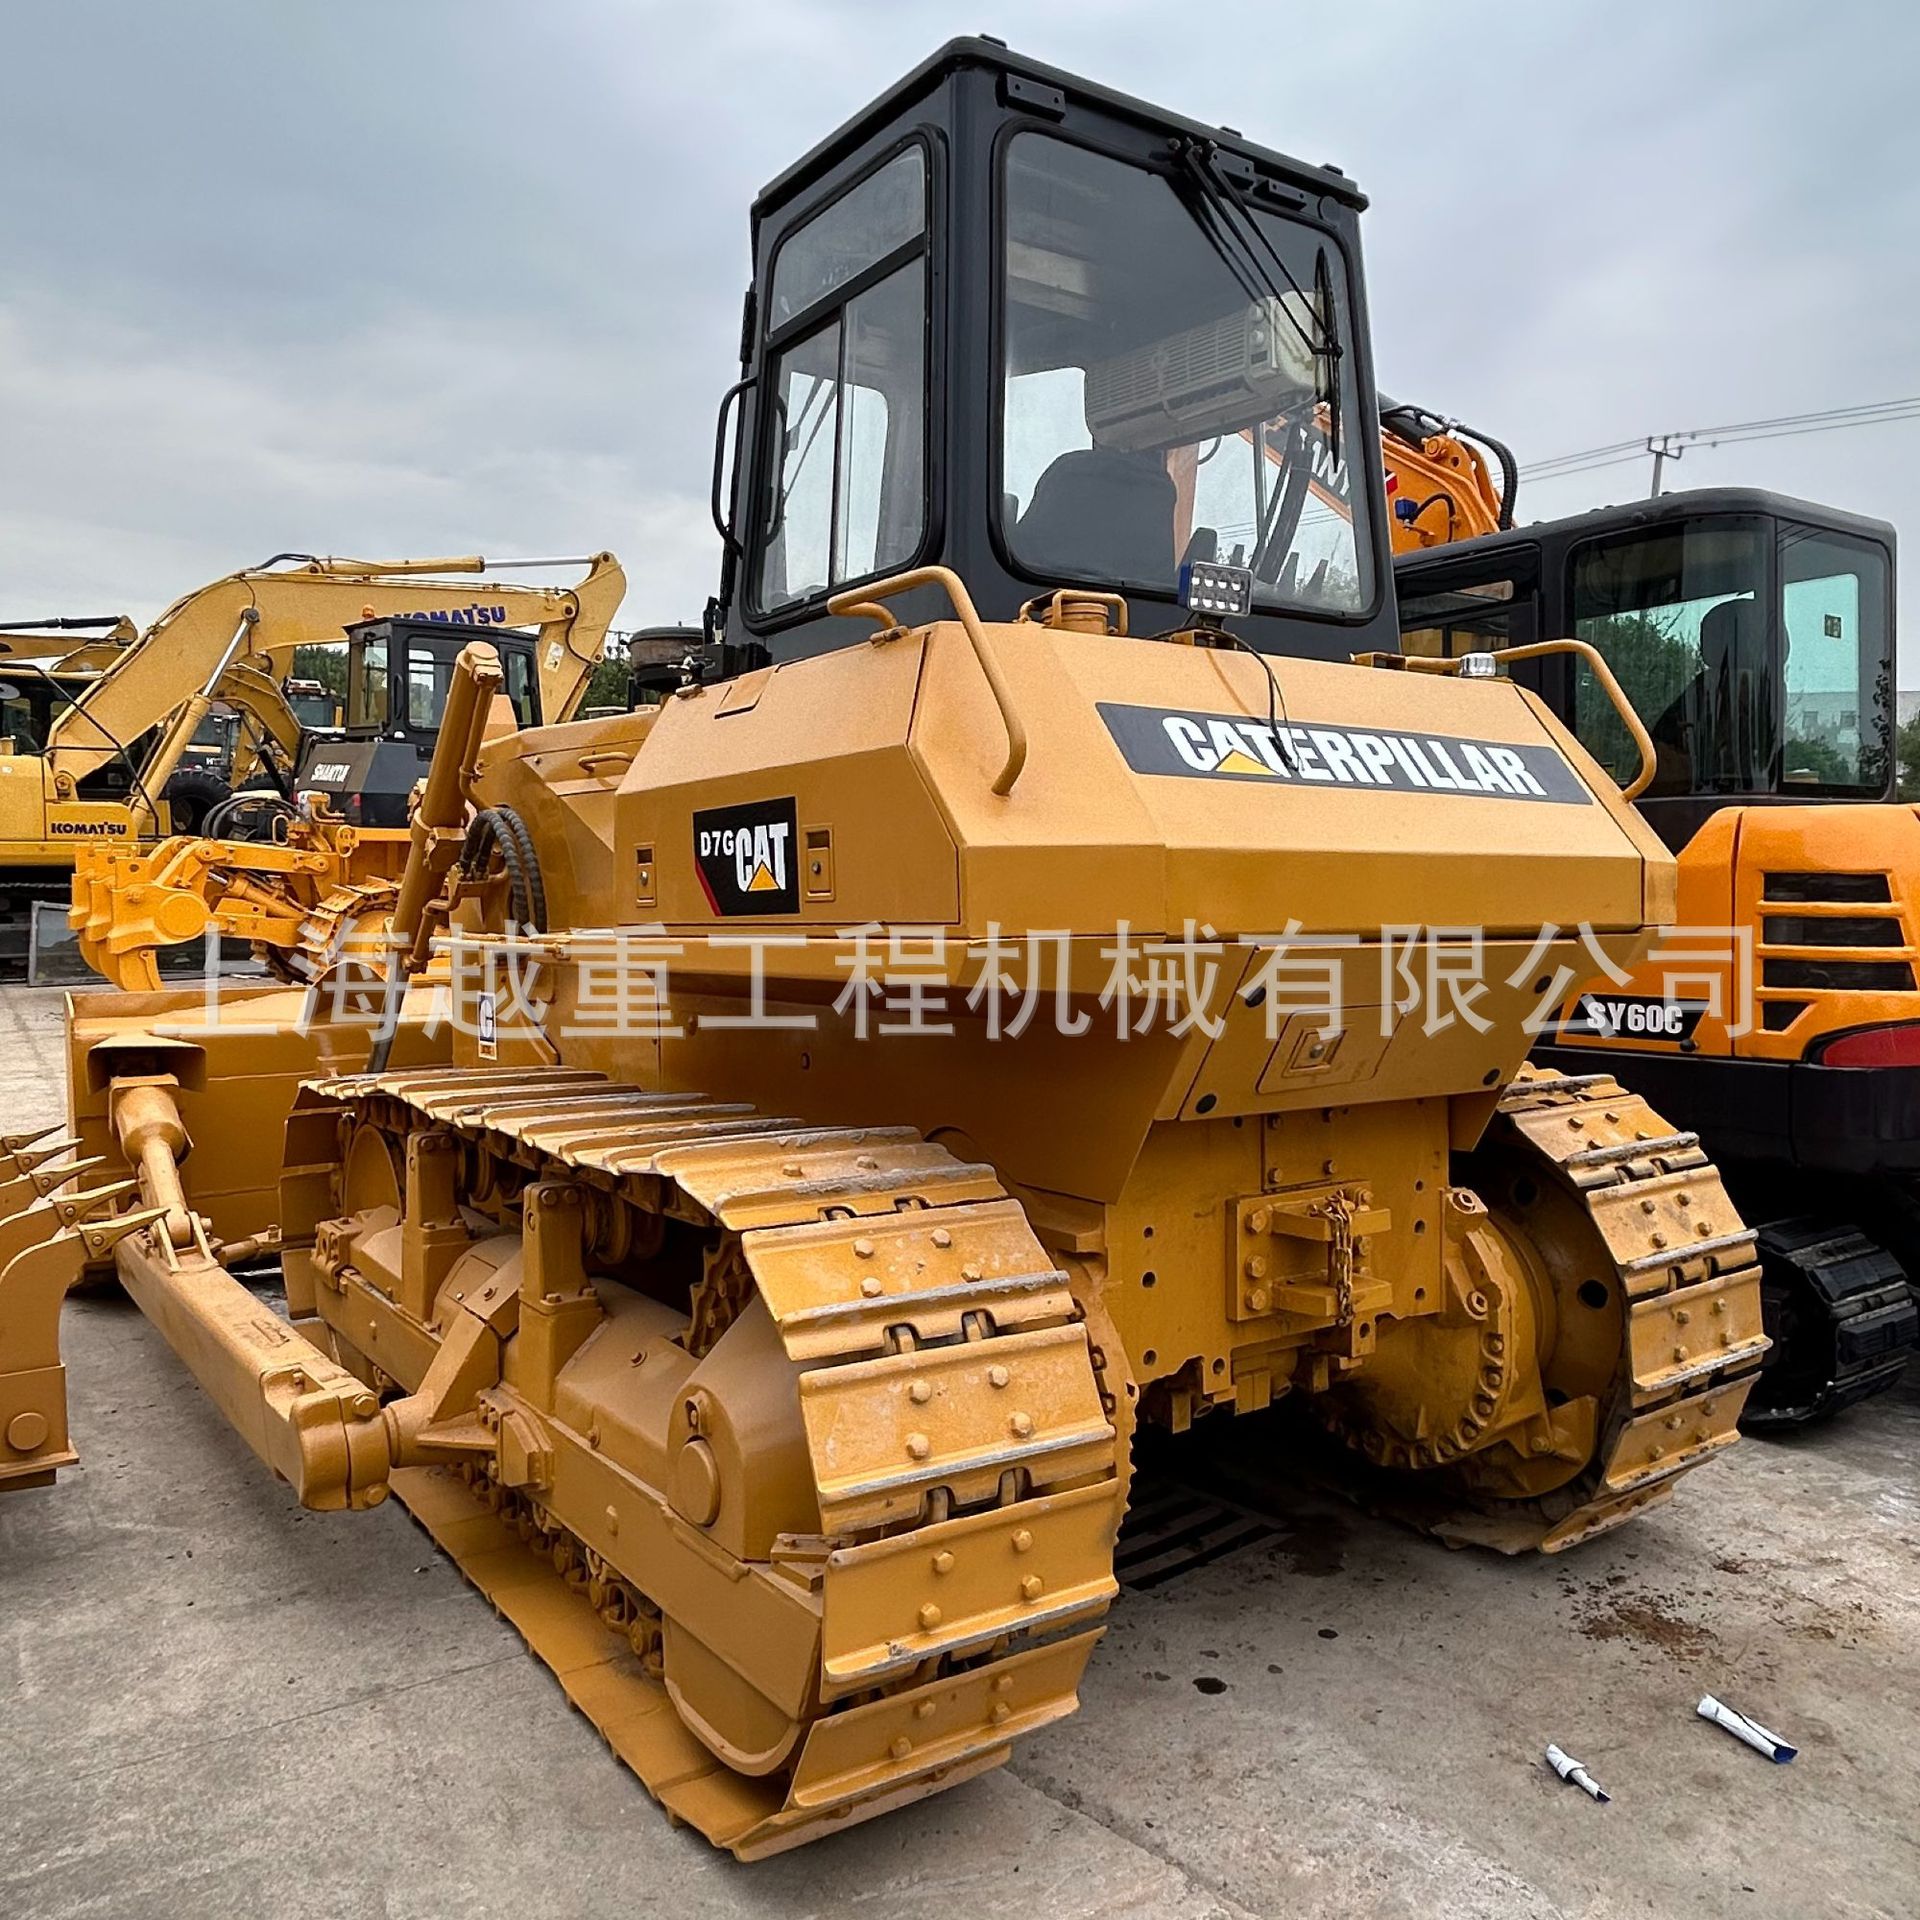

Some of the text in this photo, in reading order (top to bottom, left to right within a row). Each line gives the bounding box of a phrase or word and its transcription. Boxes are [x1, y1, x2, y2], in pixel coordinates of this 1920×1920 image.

[1162, 716, 1548, 796] CATERPILLAR
[50, 821, 127, 835] KOMATSU
[700, 829, 735, 857] D7G
[735, 822, 789, 892] CAT
[1586, 1001, 1683, 1034] SY60C
